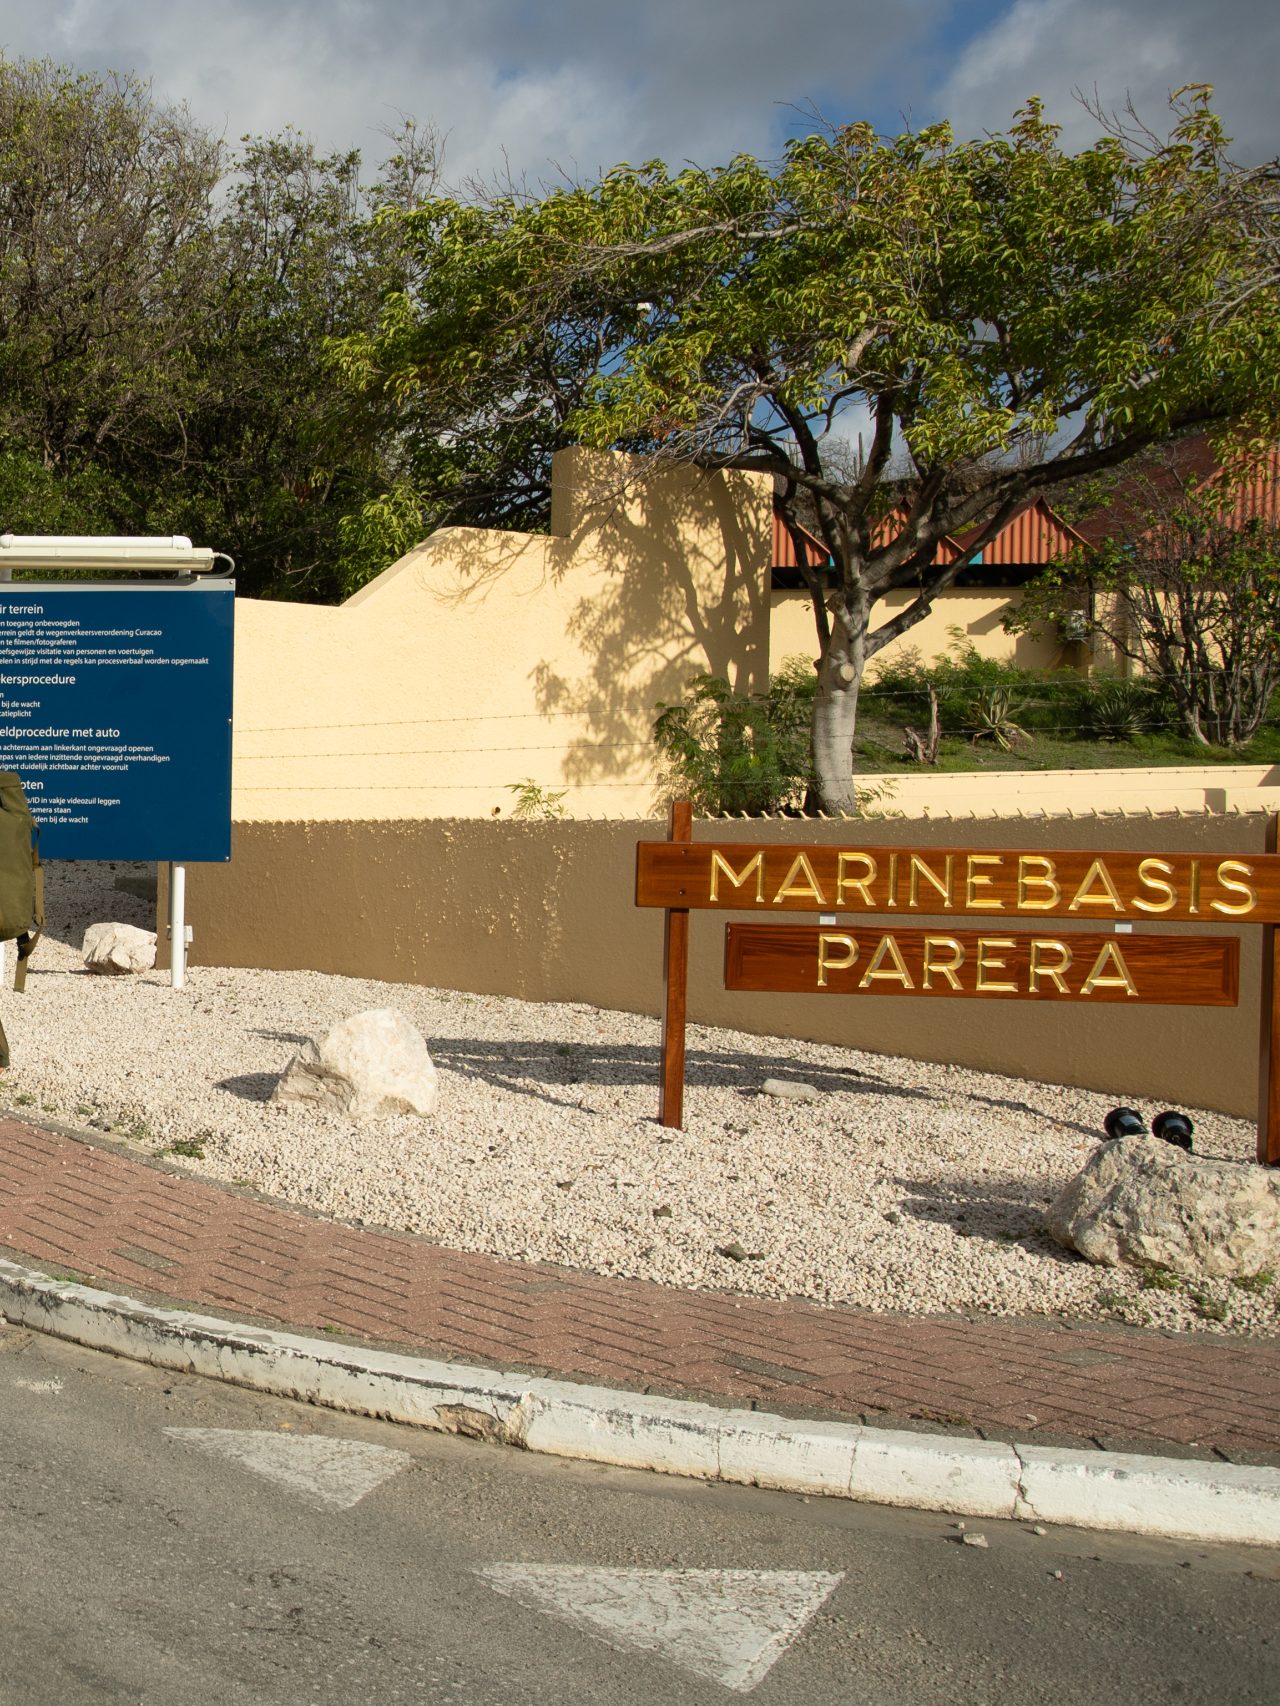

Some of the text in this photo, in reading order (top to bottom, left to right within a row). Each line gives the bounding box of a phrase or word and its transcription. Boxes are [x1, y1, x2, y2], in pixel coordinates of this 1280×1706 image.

[9, 604, 44, 615] terrein
[6, 620, 34, 628] toegang
[34, 620, 80, 628] onbevoegden
[17, 629, 35, 637] geldt
[76, 649, 107, 657] personen
[117, 648, 154, 657] voertuigen
[20, 657, 39, 665] strijd
[63, 657, 83, 666] regels
[97, 657, 143, 666] procesverbaal
[144, 657, 170, 665] worden
[171, 657, 209, 666] opgemaakt
[1, 700, 10, 709] bij
[10, 700, 20, 708] de
[20, 700, 41, 708] wacht
[72, 727, 94, 738] met
[95, 727, 121, 738] auto
[53, 744, 87, 752] linkerkant
[87, 745, 127, 753] ongevraagd
[49, 753, 83, 761] inzittende
[83, 754, 123, 762] ongevraagd
[124, 754, 170, 763] overhandigen
[20, 763, 48, 771] duidelijk
[80, 763, 101, 771] achter
[48, 797, 66, 805] vakje
[97, 797, 121, 806] leggen
[49, 816, 58, 824] bij
[708, 849, 1258, 916] MARINEBASIS
[816, 932, 1140, 997] PARERA
